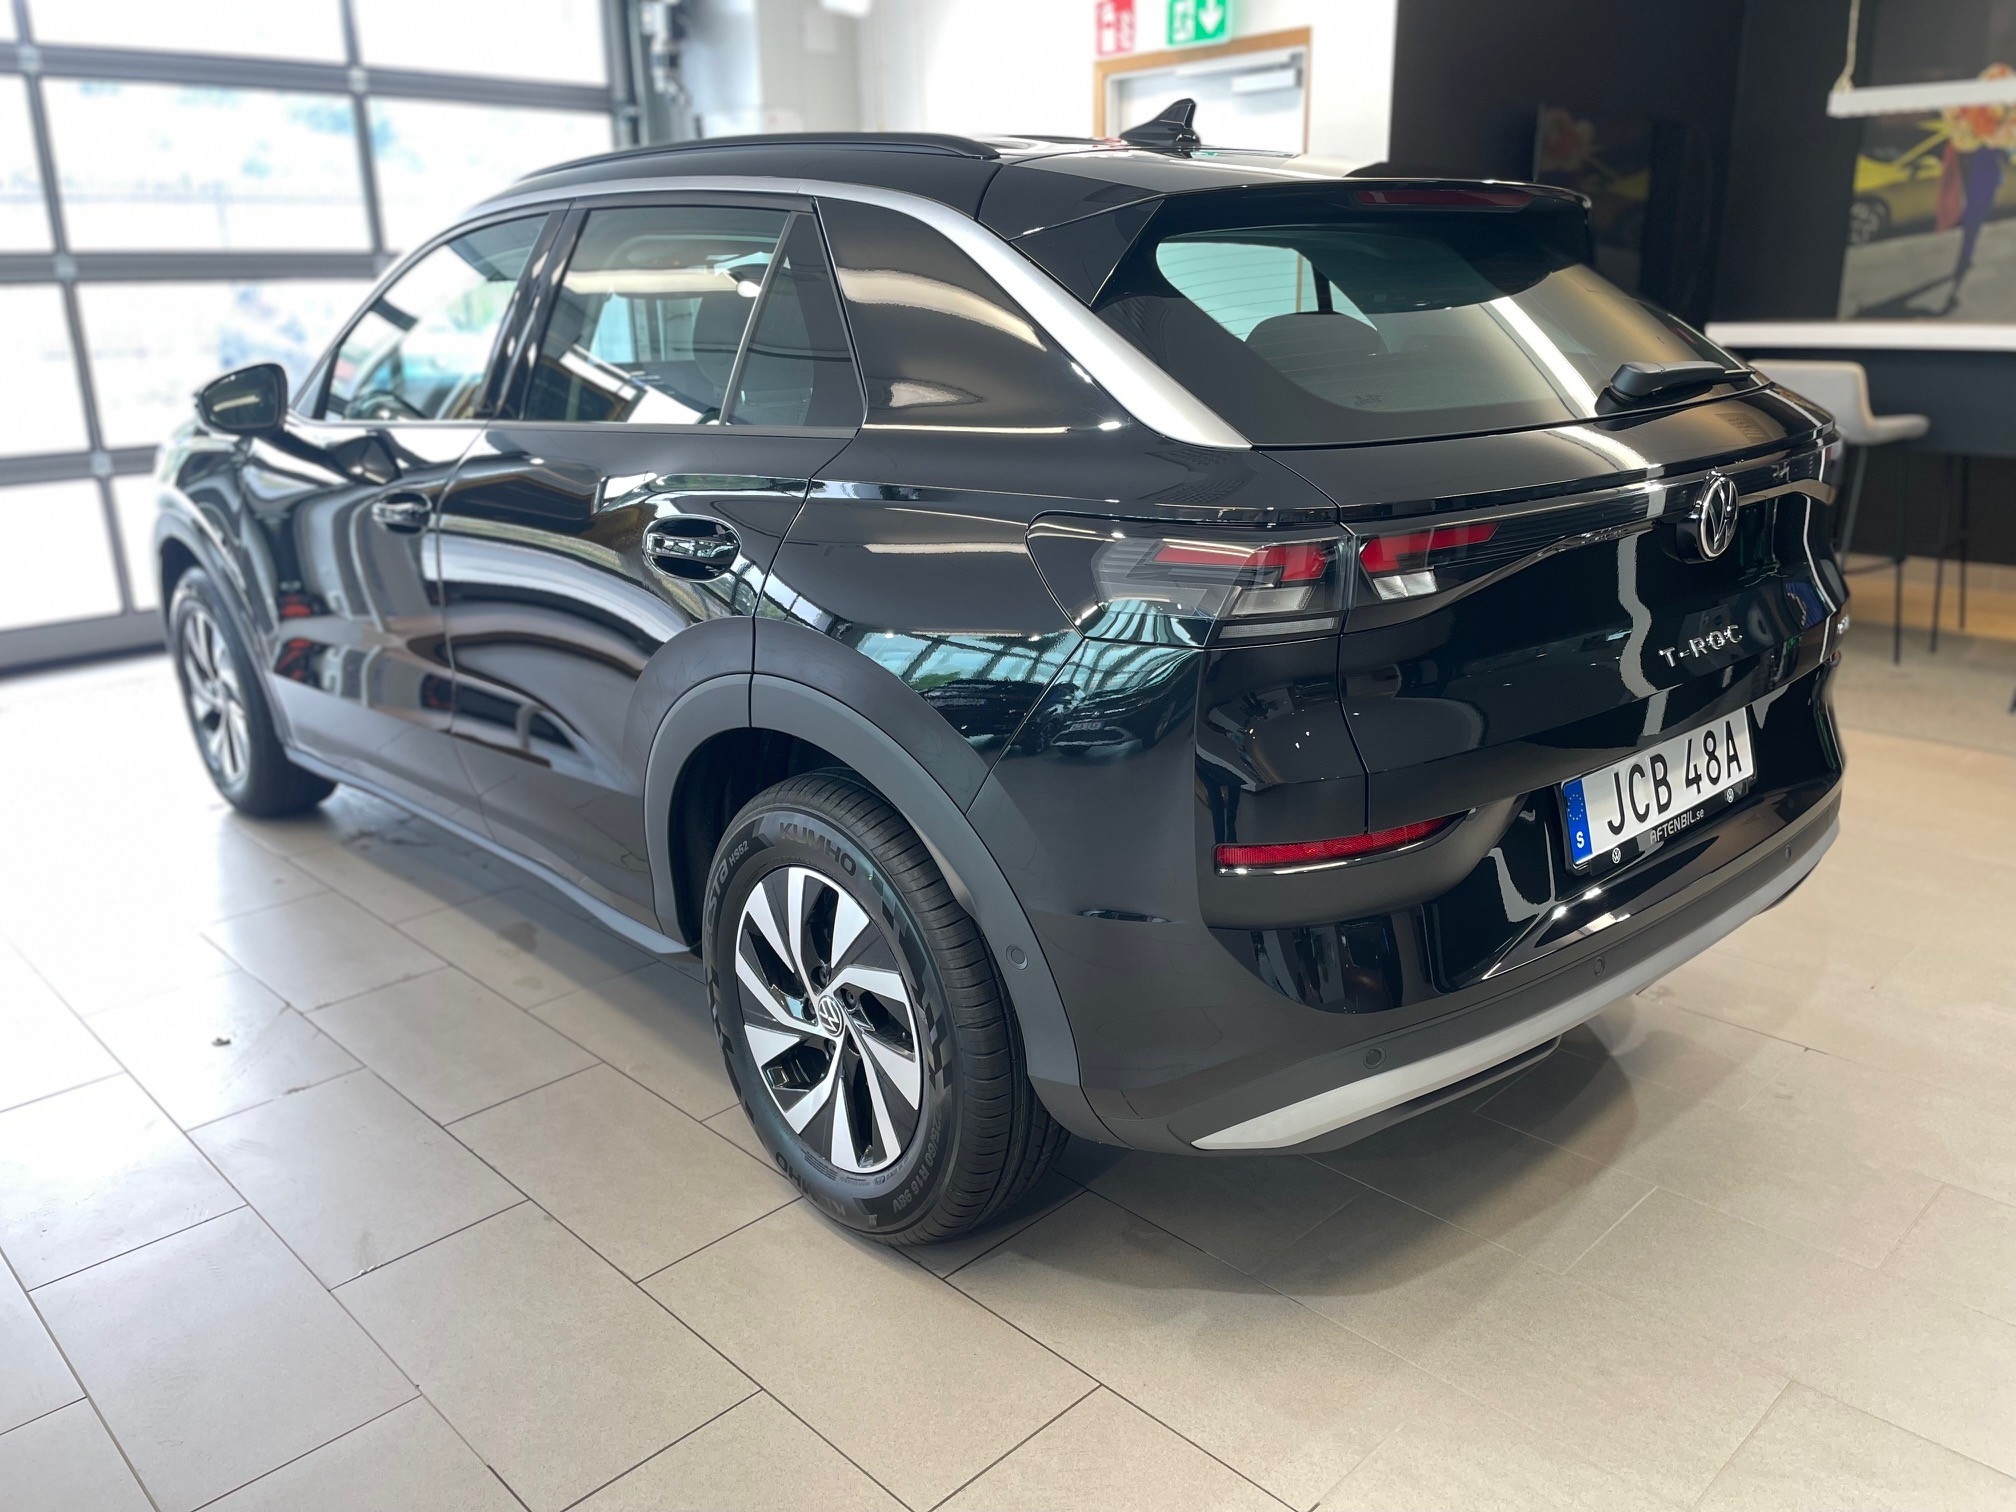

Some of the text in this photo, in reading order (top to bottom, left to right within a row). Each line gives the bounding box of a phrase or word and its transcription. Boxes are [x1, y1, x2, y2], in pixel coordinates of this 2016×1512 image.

[1658, 624, 1743, 667] T-ROC
[1607, 720, 1742, 836] JCB 48A
[1576, 831, 1585, 849] S
[1649, 808, 1705, 845] AFTENBIL.se
[728, 840, 749, 867] HS52
[779, 821, 856, 877] KUMHO
[911, 1163, 930, 1195] R16
[892, 1189, 913, 1215] 98V
